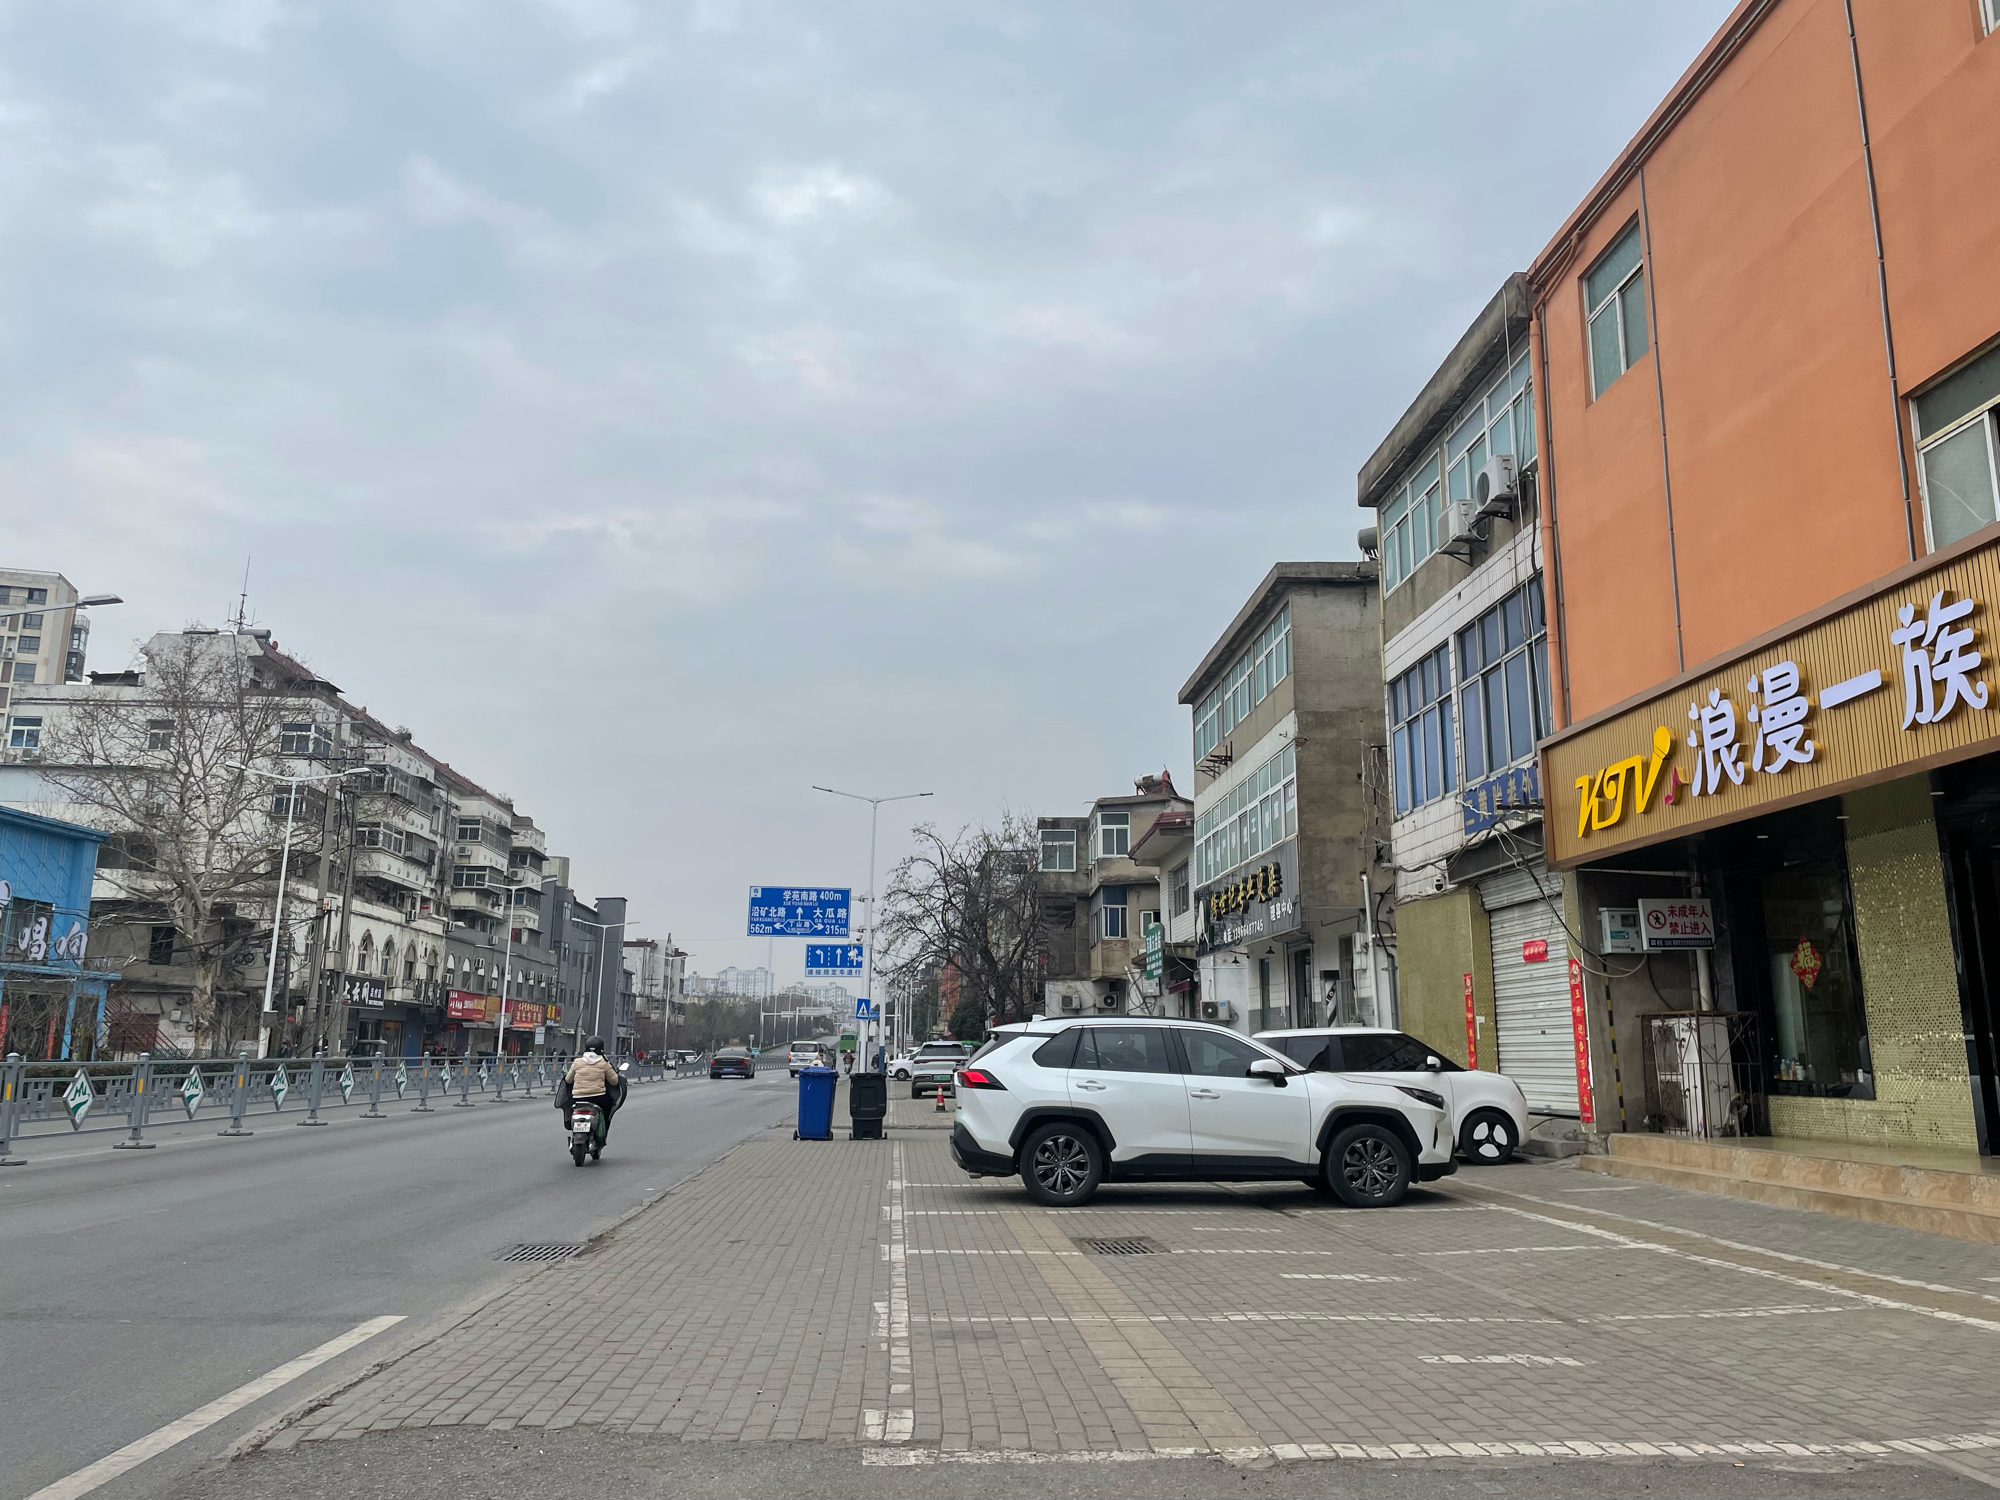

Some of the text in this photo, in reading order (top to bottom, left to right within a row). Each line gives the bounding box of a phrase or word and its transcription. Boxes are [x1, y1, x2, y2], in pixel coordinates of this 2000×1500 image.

[1575, 590, 1989, 838] KTV 浪漫一族
[783, 890, 842, 901] 学苑南路 400m
[751, 906, 786, 918] 沿矿北路
[813, 907, 848, 919] 大瓜路
[1270, 898, 1293, 921] 理容中心
[1667, 904, 1710, 918] 未成年人
[750, 924, 773, 934] 562m
[825, 924, 847, 935] 315m
[1668, 921, 1712, 936] 禁止进入
[18, 916, 88, 965] 唱响
[1797, 941, 1815, 970] 福
